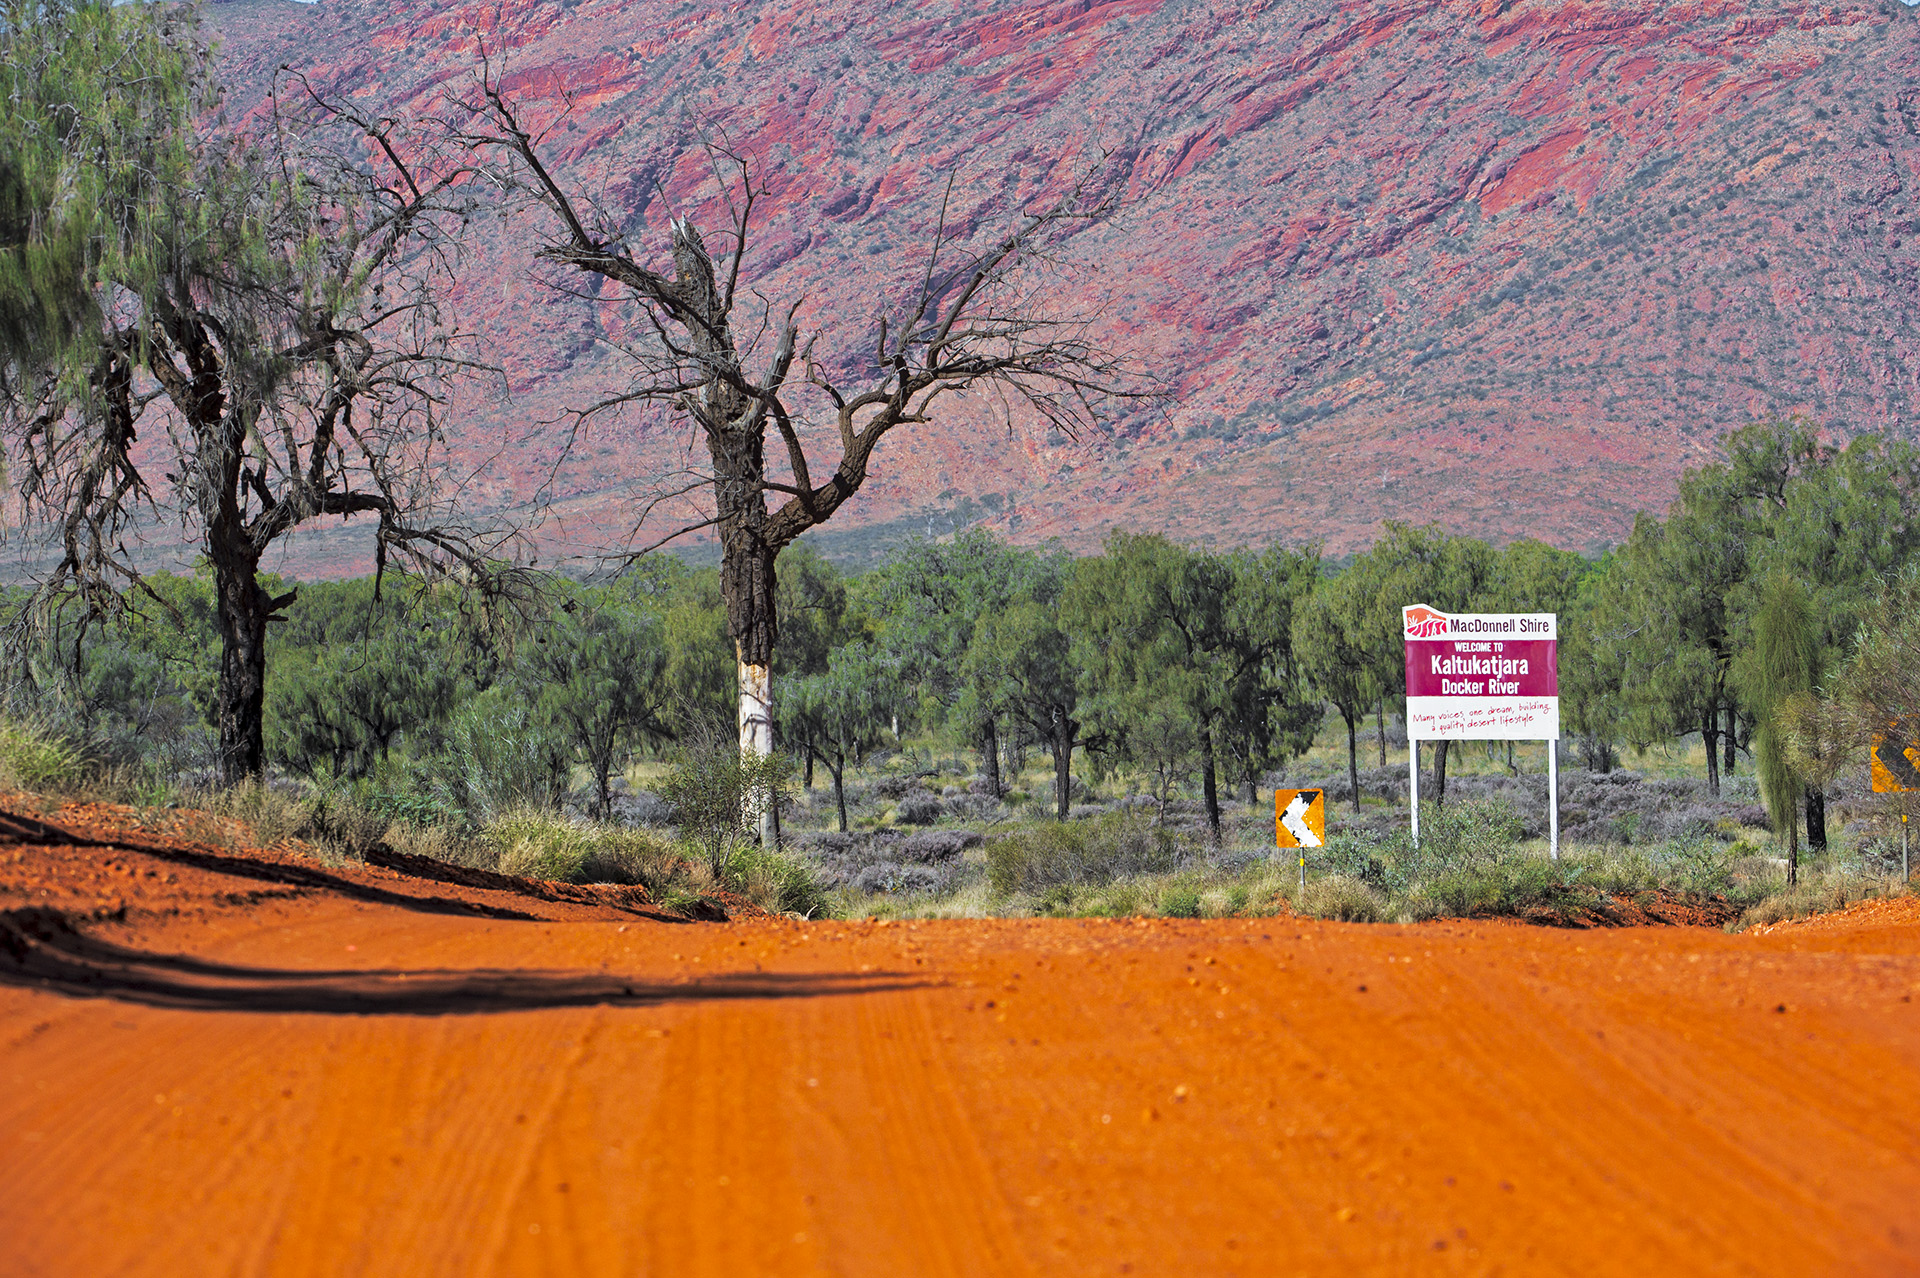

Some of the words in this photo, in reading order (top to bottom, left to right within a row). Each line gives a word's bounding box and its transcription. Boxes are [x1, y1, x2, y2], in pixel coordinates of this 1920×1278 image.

[1450, 618, 1515, 633] MacDonnell
[1519, 618, 1549, 633] Shire
[1454, 642, 1491, 652] WELCOME
[1493, 642, 1503, 652] TO
[1431, 655, 1529, 679] Kaltukatjara
[1442, 678, 1484, 695] Docker
[1488, 678, 1520, 695] River
[1413, 714, 1435, 724] Many
[1487, 705, 1515, 715] dream,
[1467, 718, 1496, 728] desert
[1500, 713, 1534, 727] lifestyle
